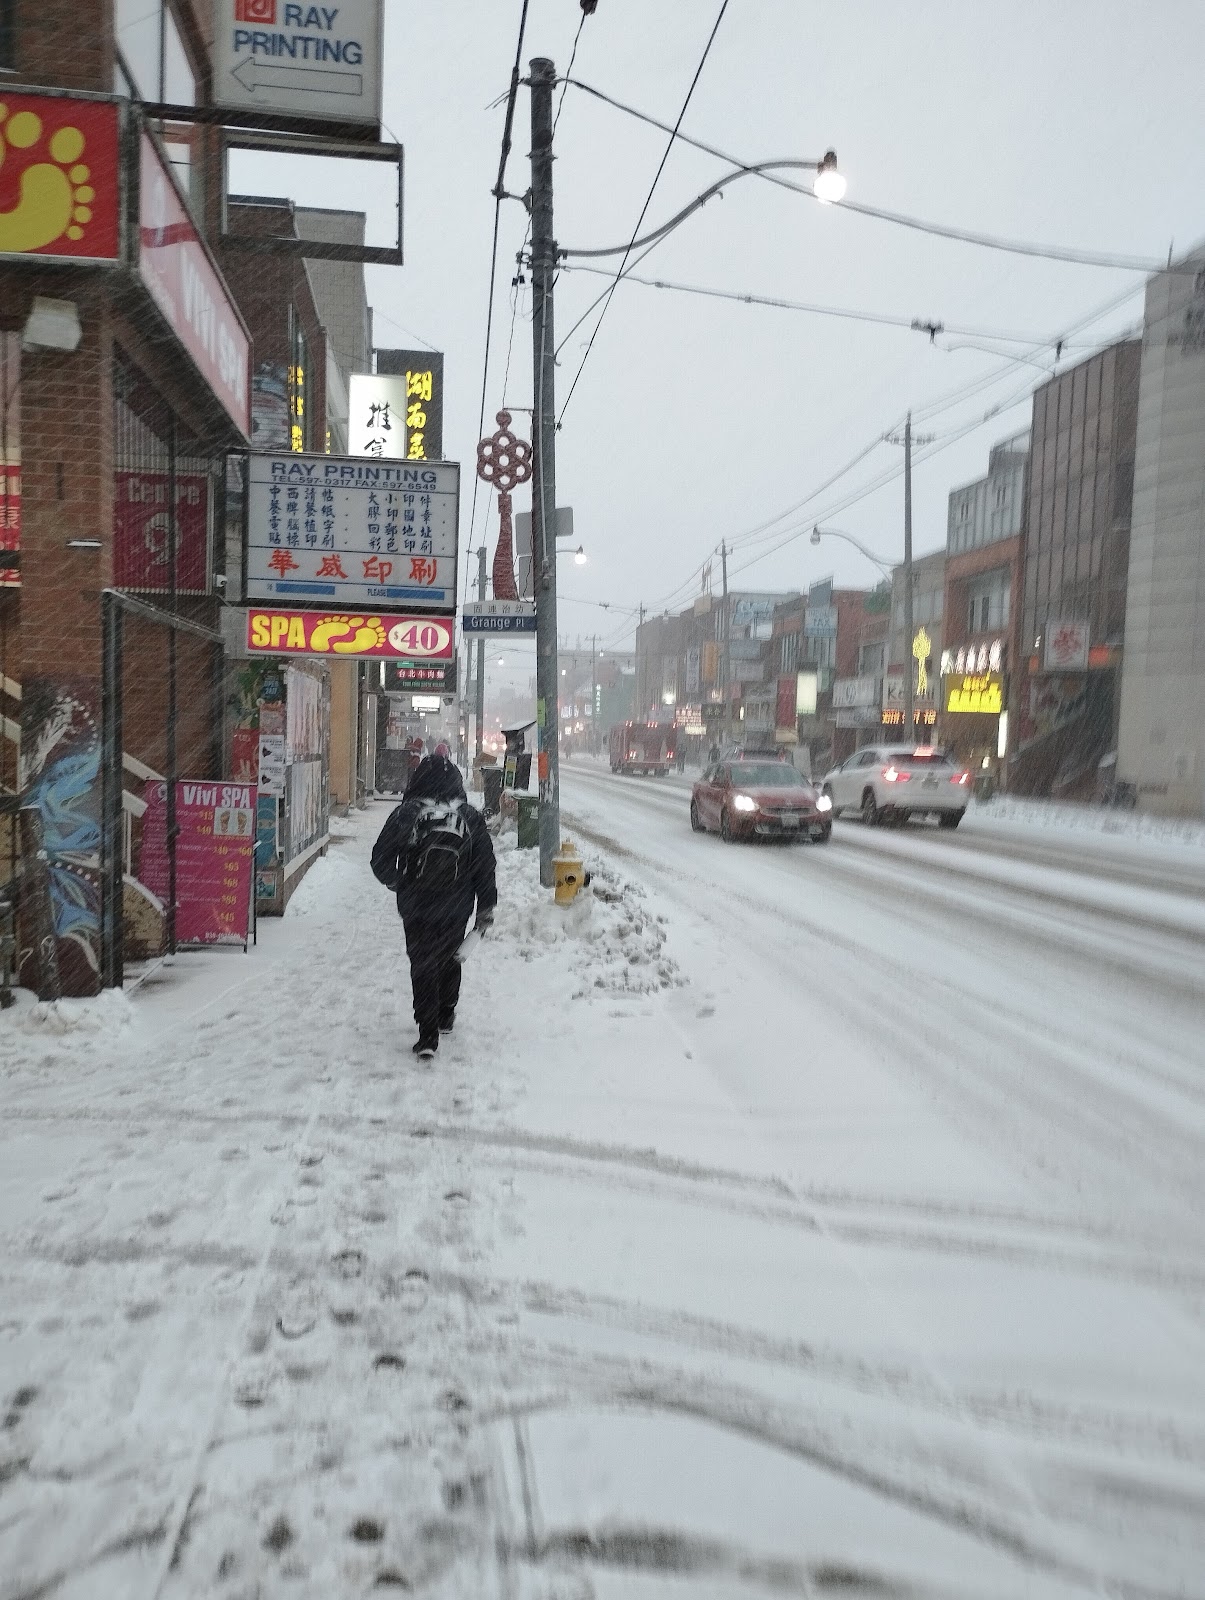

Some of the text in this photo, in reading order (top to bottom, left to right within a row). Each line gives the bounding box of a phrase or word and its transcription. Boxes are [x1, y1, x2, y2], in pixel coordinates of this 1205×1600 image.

[284, 3, 339, 31] RAY
[233, 29, 363, 65] PRINTING
[271, 461, 437, 483] RAY PRINTING
[268, 549, 437, 585] 華威印刷
[251, 614, 439, 650] SPA $40
[471, 616, 525, 630] Grange Pl
[183, 785, 250, 809] Vivi SPA
